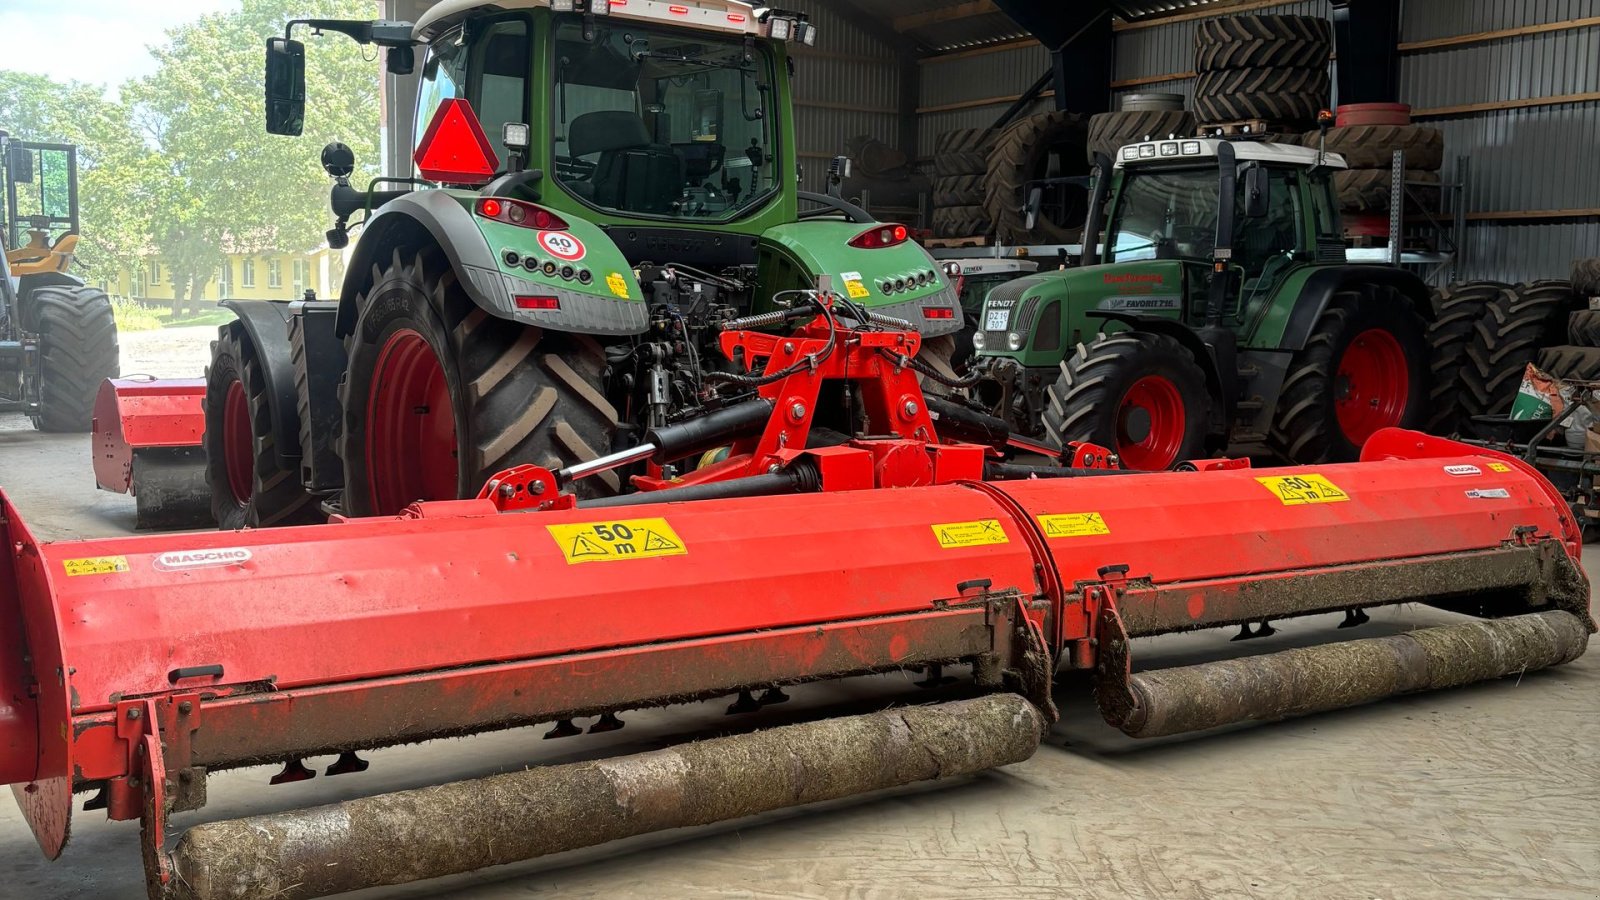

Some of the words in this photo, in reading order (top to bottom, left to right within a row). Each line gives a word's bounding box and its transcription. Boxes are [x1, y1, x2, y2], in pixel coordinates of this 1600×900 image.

[549, 237, 572, 248] 40
[1126, 299, 1158, 308] FAVORIT
[1282, 477, 1312, 490] 50
[1305, 491, 1320, 499] m
[593, 523, 634, 541] 50
[614, 542, 637, 554] m
[164, 550, 247, 565] MASCHIO
